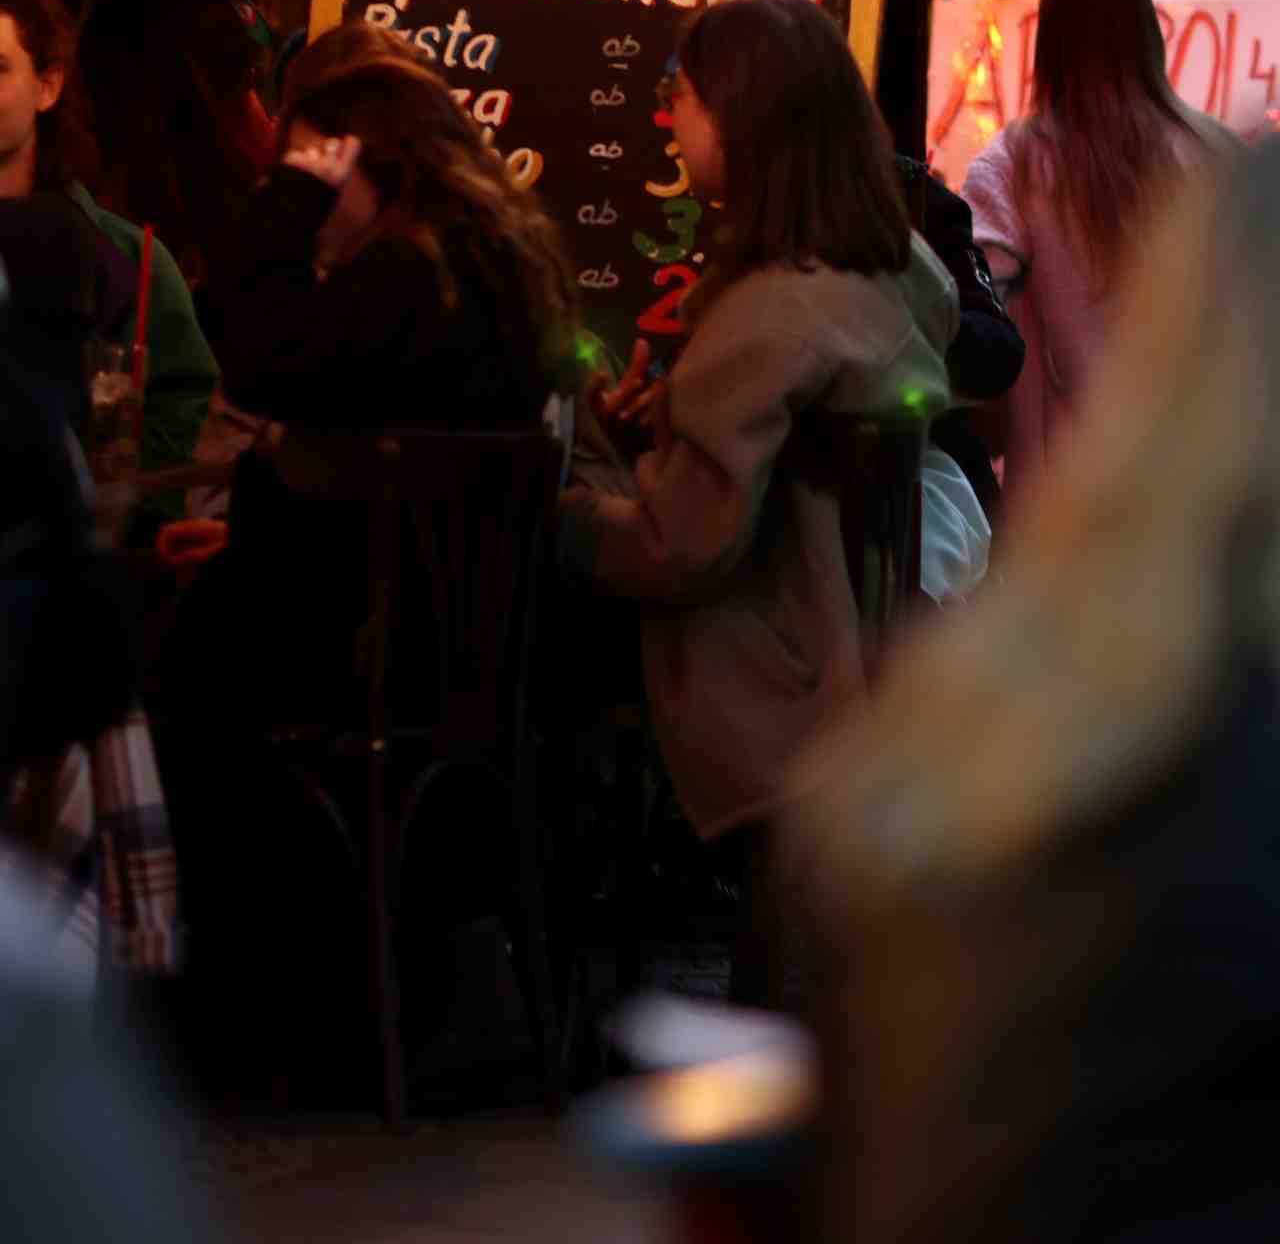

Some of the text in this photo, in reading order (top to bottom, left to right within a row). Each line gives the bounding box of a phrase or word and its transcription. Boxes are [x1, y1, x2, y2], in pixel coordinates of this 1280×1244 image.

[364, 2, 641, 71] Psta ab
[590, 87, 625, 106] ab
[588, 142, 624, 160] ab
[577, 202, 619, 225] ab
[577, 268, 620, 289] ab
